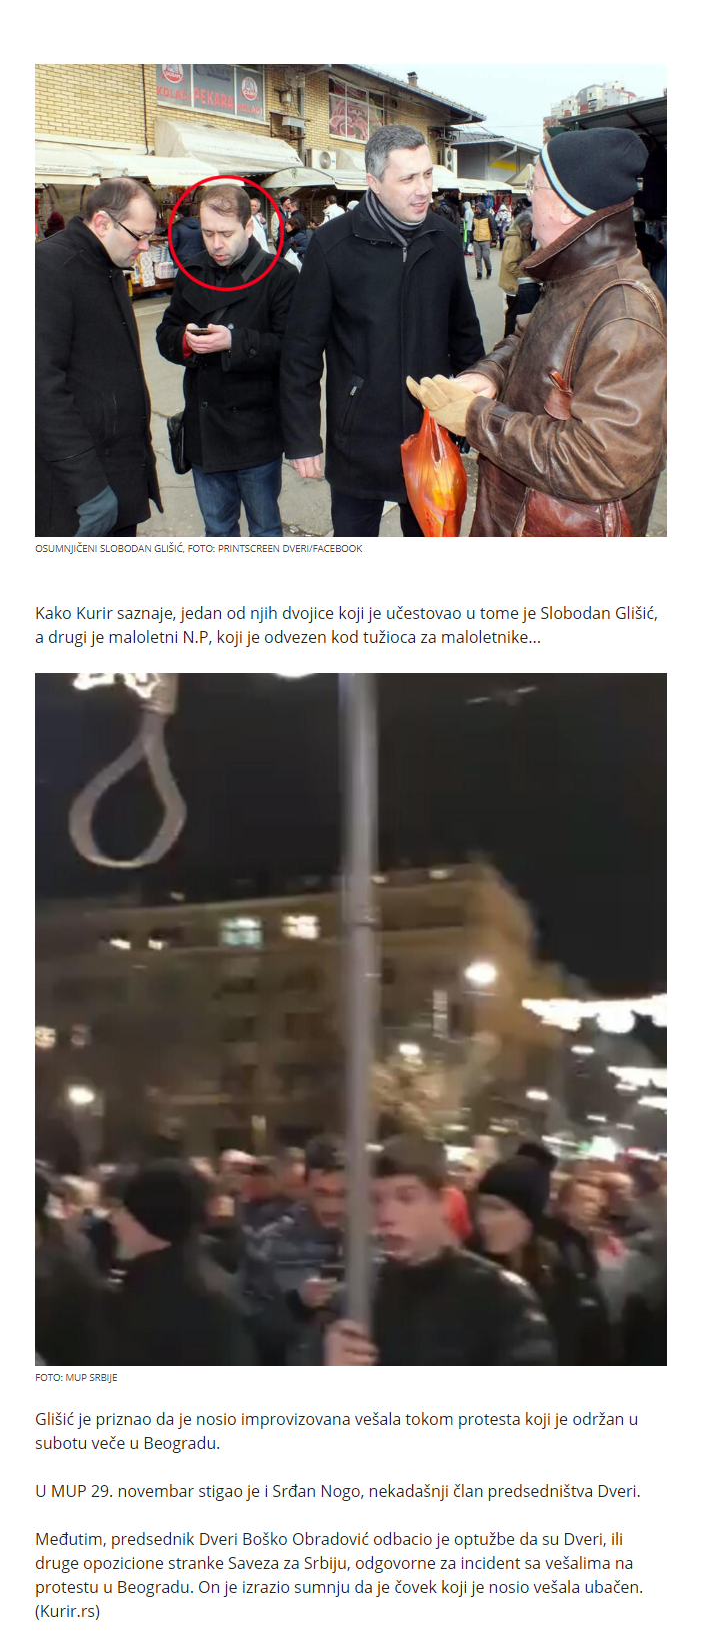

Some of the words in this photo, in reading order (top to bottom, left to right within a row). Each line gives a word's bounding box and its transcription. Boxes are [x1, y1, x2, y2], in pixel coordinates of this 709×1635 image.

[194, 88, 234, 109] PEKARA
[35, 541, 98, 555] OSUMNJIČENI
[99, 544, 152, 553] SLOBODAN
[154, 541, 185, 554] GLIŠIĆ,
[187, 544, 216, 553] FOTO:
[218, 544, 280, 553] PRINTSCREEN
[282, 544, 363, 553] DVERI/FACEBOOK
[35, 605, 72, 620] Kako
[76, 606, 114, 620] Kurir
[116, 606, 177, 624] saznaje,
[179, 605, 222, 624] jedan
[226, 605, 246, 620] od
[250, 605, 278, 624] njih
[282, 605, 334, 624] dvojice
[338, 605, 364, 624] koji
[366, 606, 382, 624] je
[386, 605, 462, 620] učestovao
[466, 609, 476, 620] u
[479, 607, 519, 620] tome
[521, 606, 537, 624] je
[540, 605, 611, 620] Slobodan
[615, 605, 658, 622] Glišić,
[34, 633, 44, 644] a
[48, 629, 87, 648] drugi
[89, 630, 105, 648] je
[108, 629, 178, 644] maloletni
[183, 630, 213, 646] N.P,
[217, 629, 243, 648] koji
[245, 630, 260, 648] je
[264, 629, 327, 644] odvezen
[331, 629, 359, 644] kod
[362, 629, 416, 644] tužioca
[420, 633, 437, 644] za
[441, 629, 541, 644] maloletnike...
[35, 1373, 64, 1382] FOTO:
[65, 1373, 88, 1382] MUP
[89, 1373, 118, 1384] SRBIJE
[35, 1411, 75, 1426] Glišić
[76, 1412, 92, 1430] je
[96, 1412, 152, 1430] priznao
[155, 1411, 174, 1426] da
[177, 1412, 192, 1430] je
[196, 1412, 237, 1426] nosio
[241, 1412, 351, 1430] improvizovana
[354, 1411, 401, 1426] vešala
[404, 1411, 454, 1426] tokom
[458, 1413, 521, 1430] protesta
[525, 1411, 551, 1430] koji
[553, 1412, 568, 1430] je
[572, 1411, 624, 1426] održan
[629, 1415, 638, 1426] u
[35, 1435, 87, 1450] subotu
[91, 1435, 126, 1450] veče
[129, 1439, 139, 1450] u
[144, 1435, 220, 1454] Beogradu.
[35, 1484, 46, 1498] U
[51, 1484, 87, 1498] MUP
[90, 1484, 113, 1498] 29.
[118, 1483, 195, 1498] novembar
[198, 1484, 243, 1502] stigao
[245, 1484, 260, 1502] je
[264, 1484, 268, 1498] i
[272, 1483, 316, 1498] Srđan
[321, 1484, 365, 1502] Nogo,
[369, 1483, 449, 1502] nekadašnji
[453, 1483, 484, 1498] član
[488, 1483, 593, 1502] predsedništva
[598, 1484, 641, 1498] Dveri.
[35, 1531, 107, 1548] Međutim,
[111, 1531, 195, 1550] predsednik
[199, 1532, 238, 1546] Dveri
[242, 1531, 288, 1546] Boško
[292, 1531, 370, 1546] Obradović
[373, 1531, 433, 1546] odbacio
[434, 1532, 450, 1550] je
[453, 1531, 515, 1550] optužbe
[519, 1531, 538, 1546] da
[542, 1535, 559, 1546] su
[564, 1532, 607, 1548] Dveri,
[611, 1531, 623, 1546] ili
[34, 1604, 100, 1621] (Kurir.rs)
